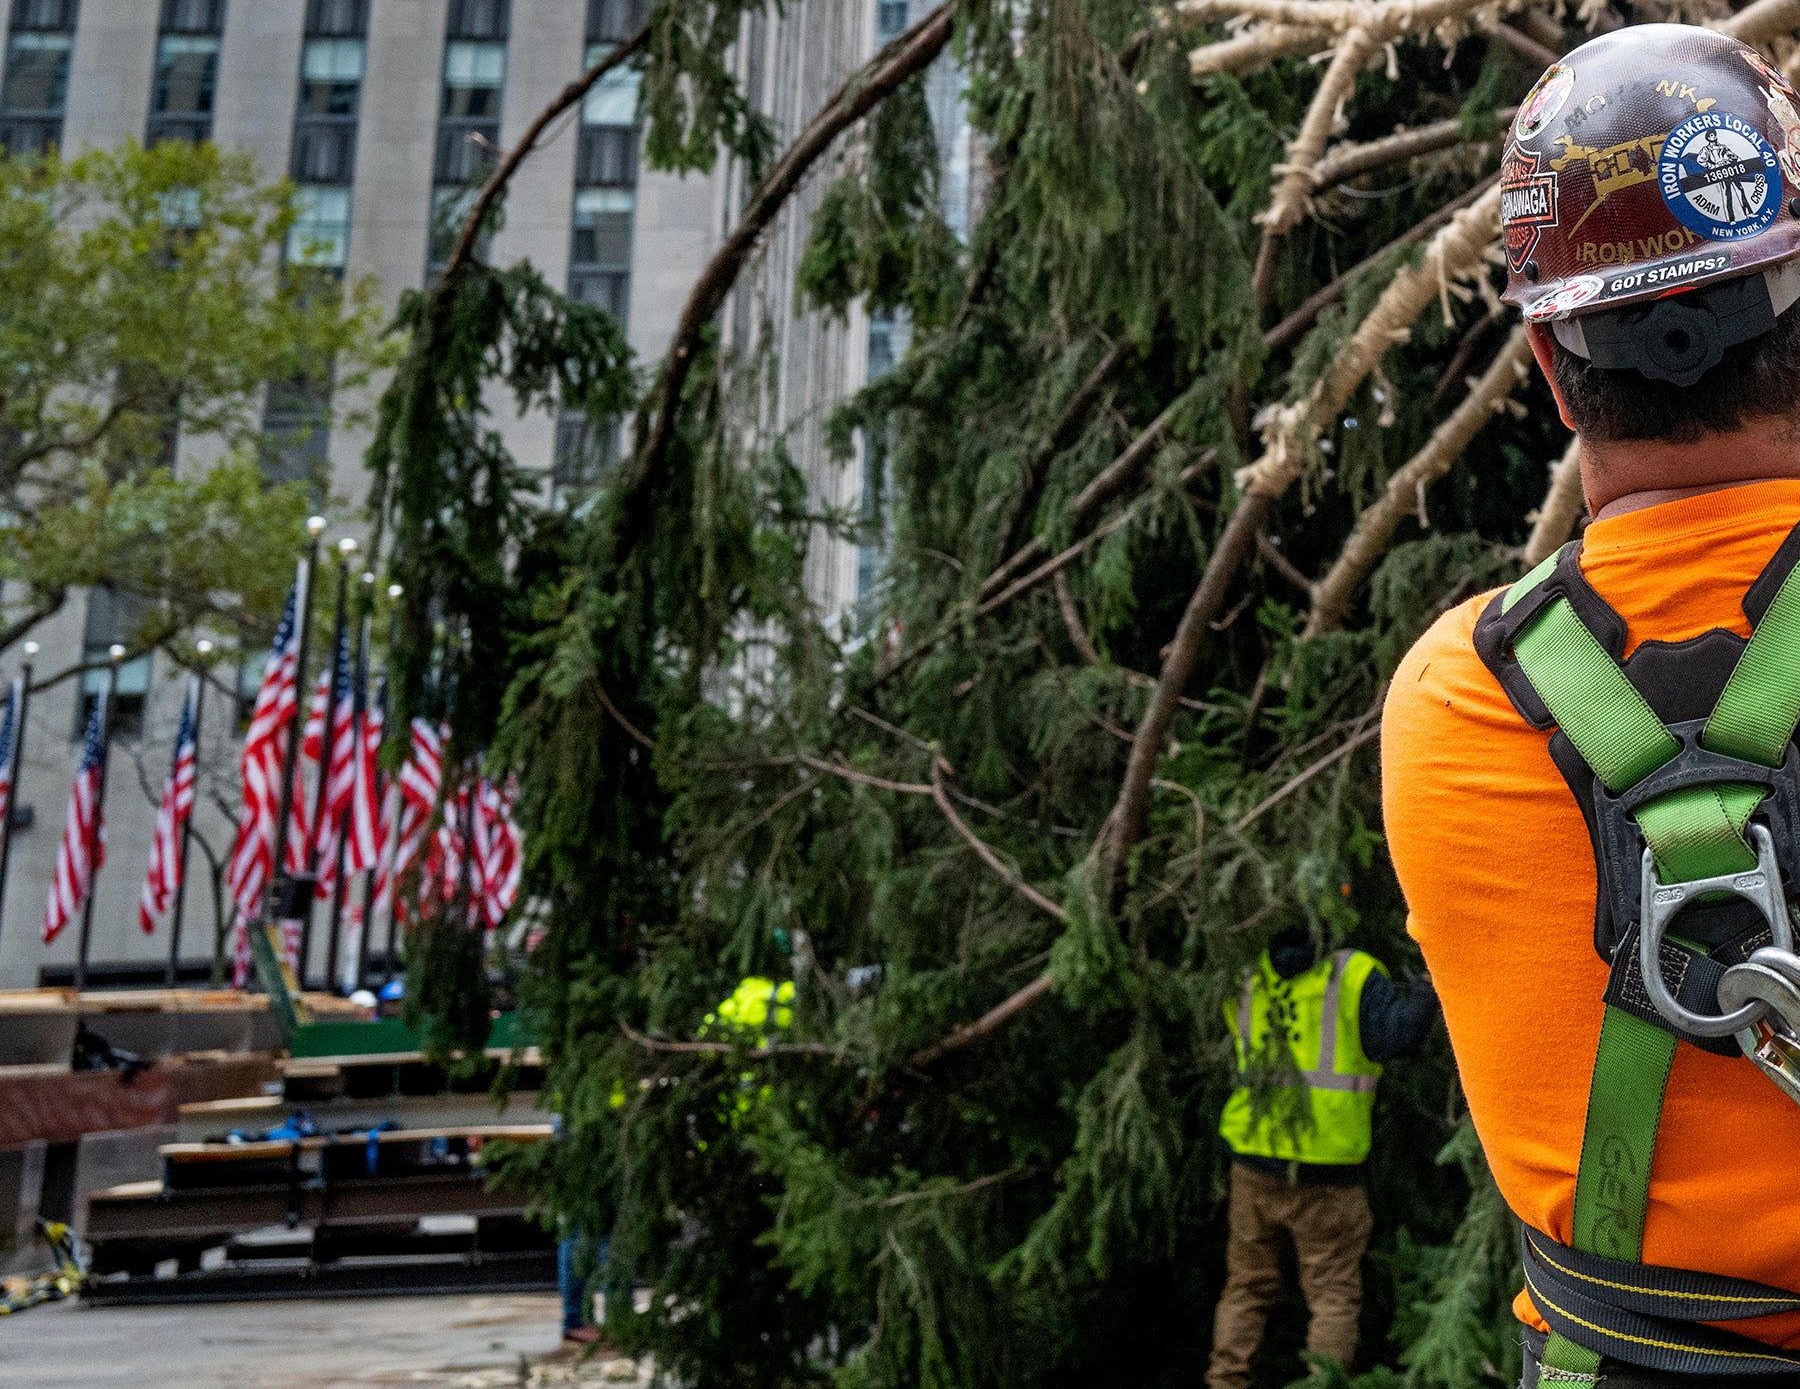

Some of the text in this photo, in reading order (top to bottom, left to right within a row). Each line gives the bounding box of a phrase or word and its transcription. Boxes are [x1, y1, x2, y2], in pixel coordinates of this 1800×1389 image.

[1662, 114, 1776, 200] IRON WORKERS LOCAL 40
[1704, 163, 1746, 183] 1369018
[1692, 193, 1721, 217] ADAM
[1750, 173, 1766, 205] CROSS
[1711, 207, 1774, 237] NEW YORK, N.Y.
[1576, 239, 1636, 263] IRON
[1610, 256, 1727, 293] GOT STAMPS?
